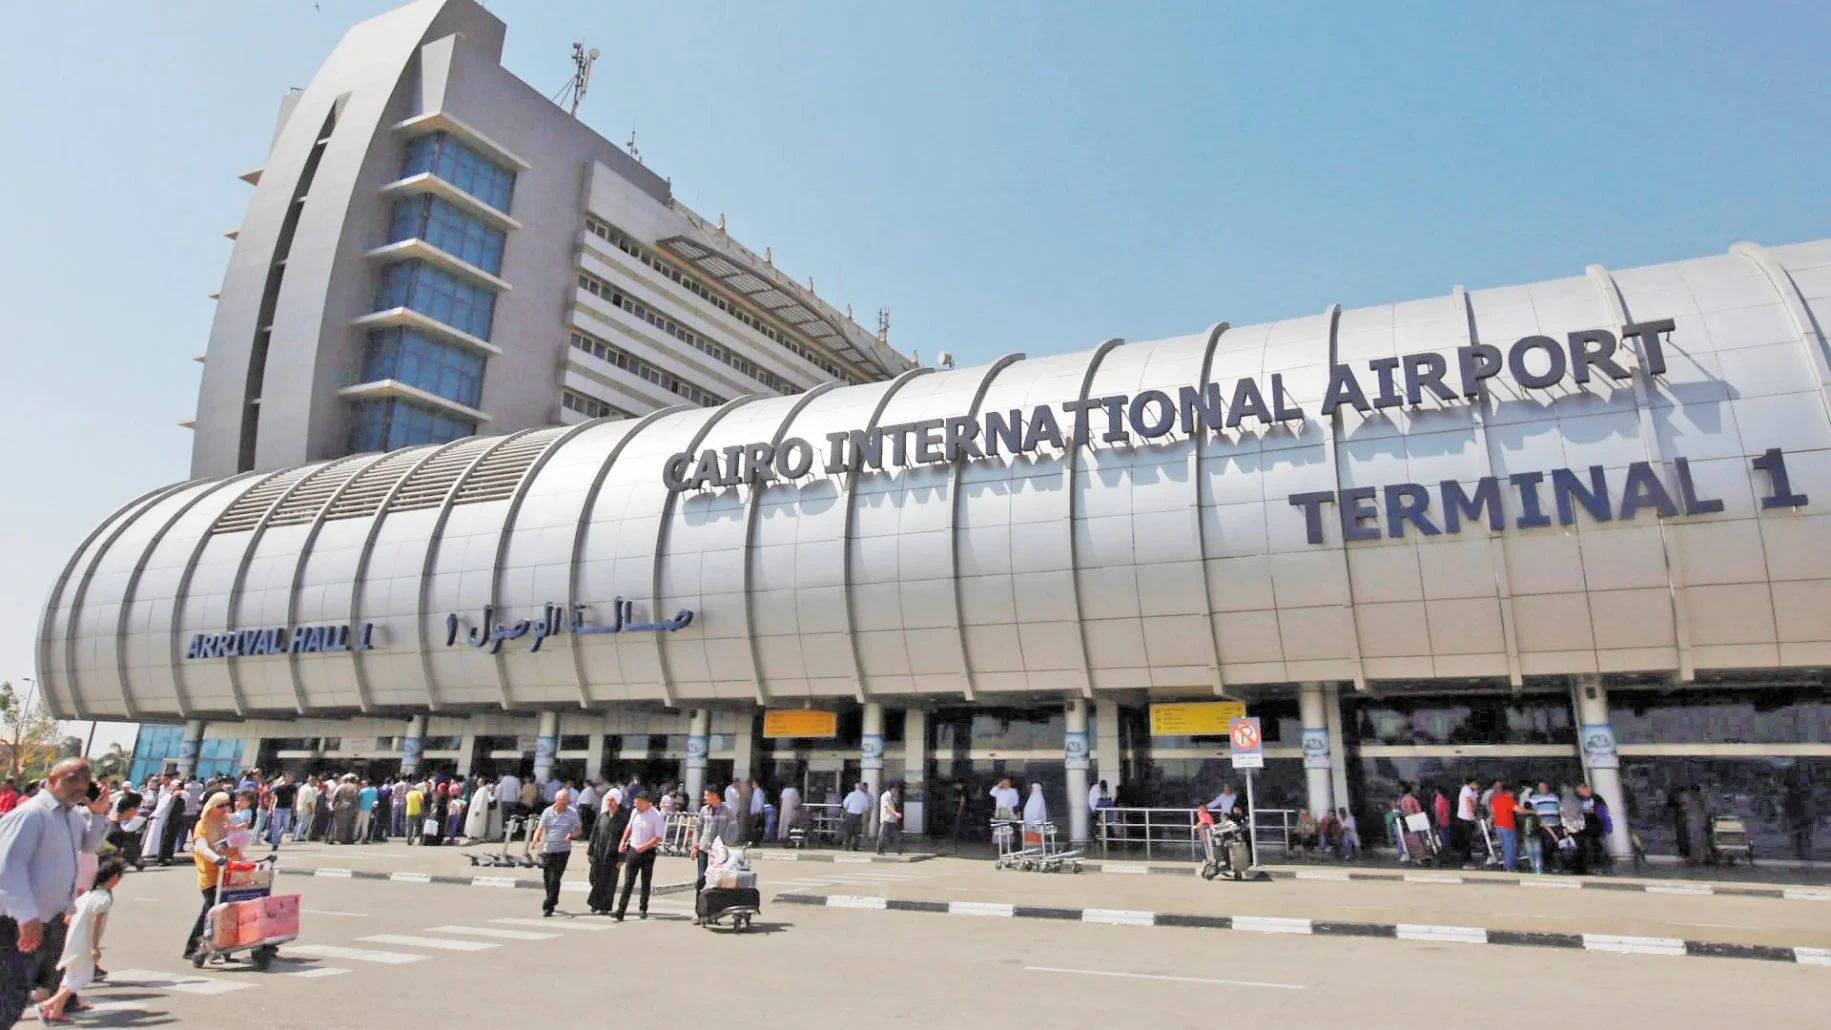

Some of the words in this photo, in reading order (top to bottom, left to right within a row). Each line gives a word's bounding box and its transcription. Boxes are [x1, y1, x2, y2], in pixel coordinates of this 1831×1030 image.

[663, 436, 814, 492] CAIRO
[825, 373, 1304, 475] INTERNATIONAL
[1321, 318, 1676, 416] AIRPORT
[1289, 456, 1725, 545] TERMINAL
[1752, 447, 1809, 509] 1
[186, 627, 288, 659] ARRIVAL
[288, 624, 351, 654] HALL
[358, 622, 374, 651] 1
[467, 601, 562, 654] الوصول
[569, 596, 694, 635] صالة
